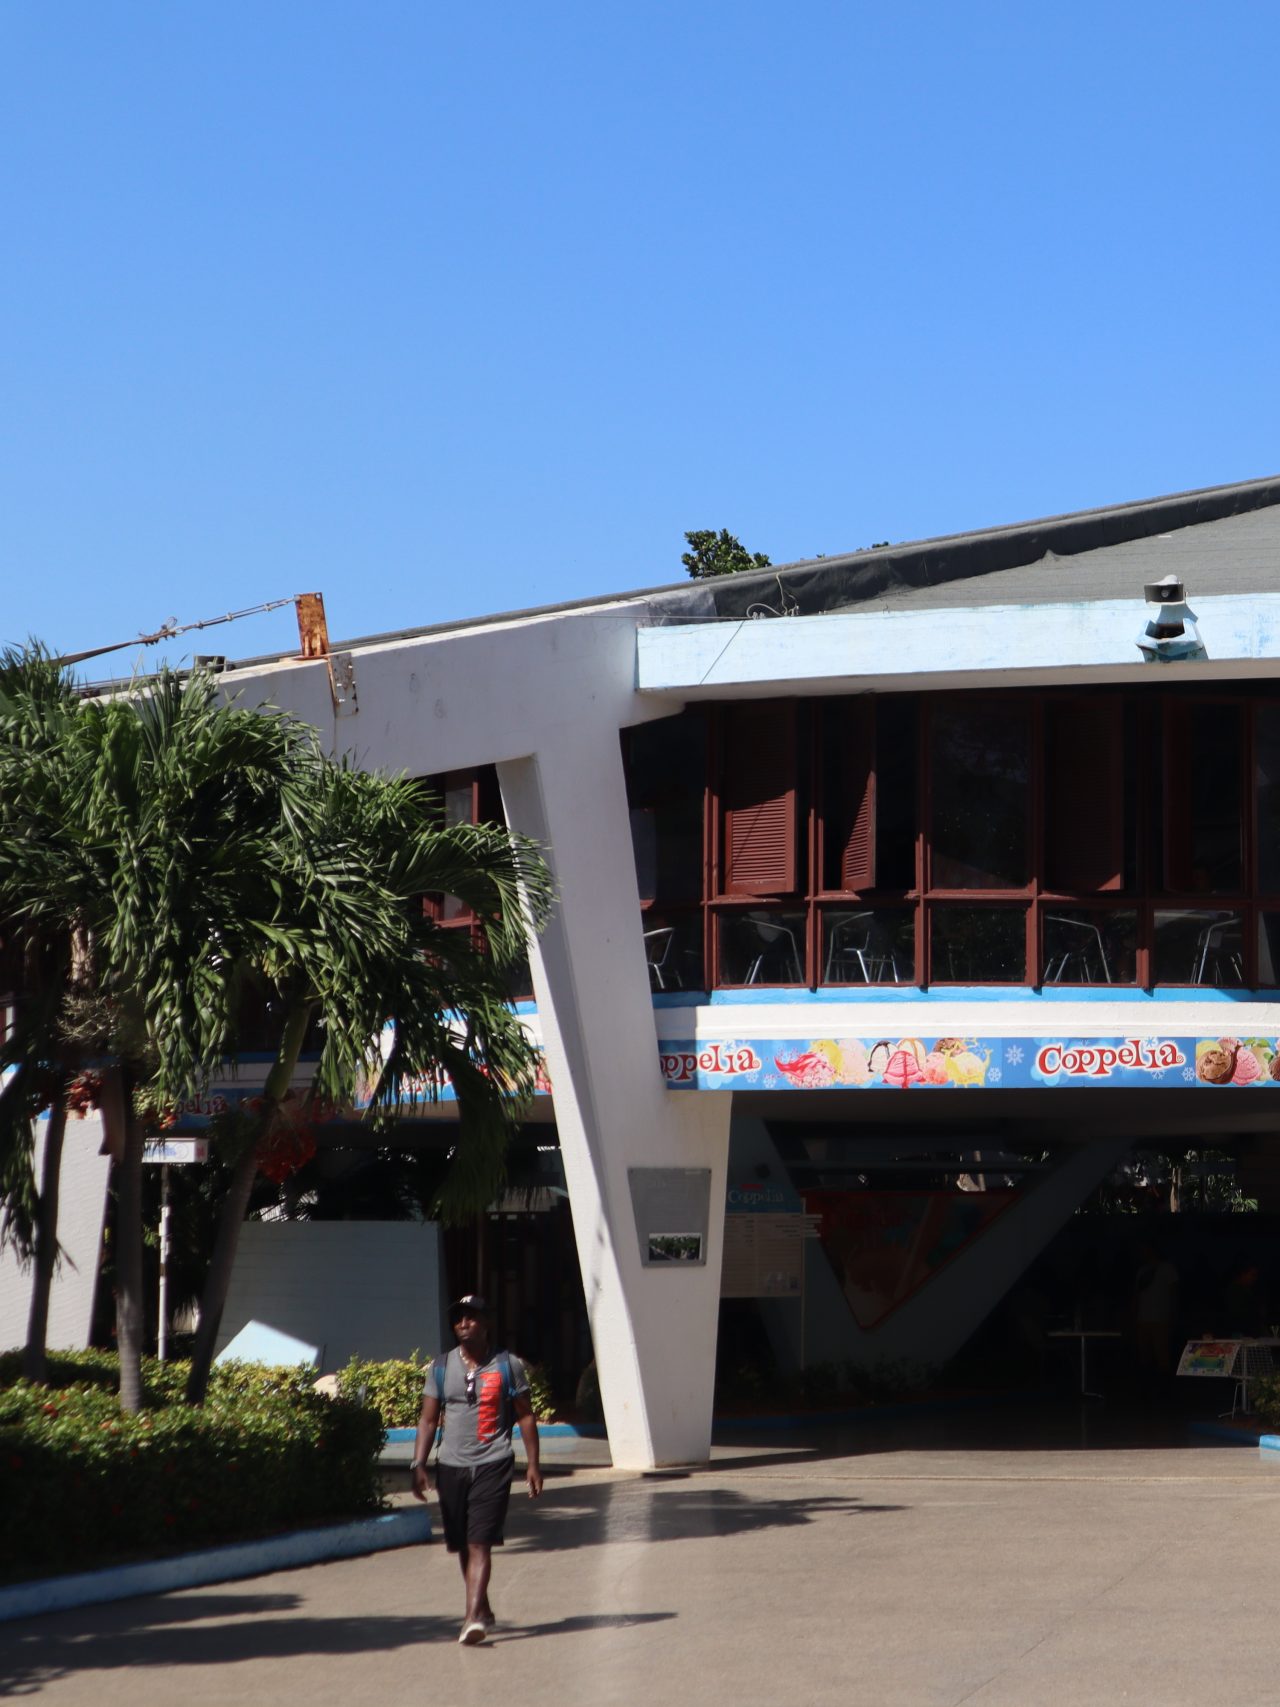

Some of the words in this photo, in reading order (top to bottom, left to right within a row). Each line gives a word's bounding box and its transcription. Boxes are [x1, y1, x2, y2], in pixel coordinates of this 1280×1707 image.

[660, 1045, 756, 1080] ppelia
[1038, 1039, 1180, 1075] Coppelia
[728, 1188, 784, 1204] Coppelia
